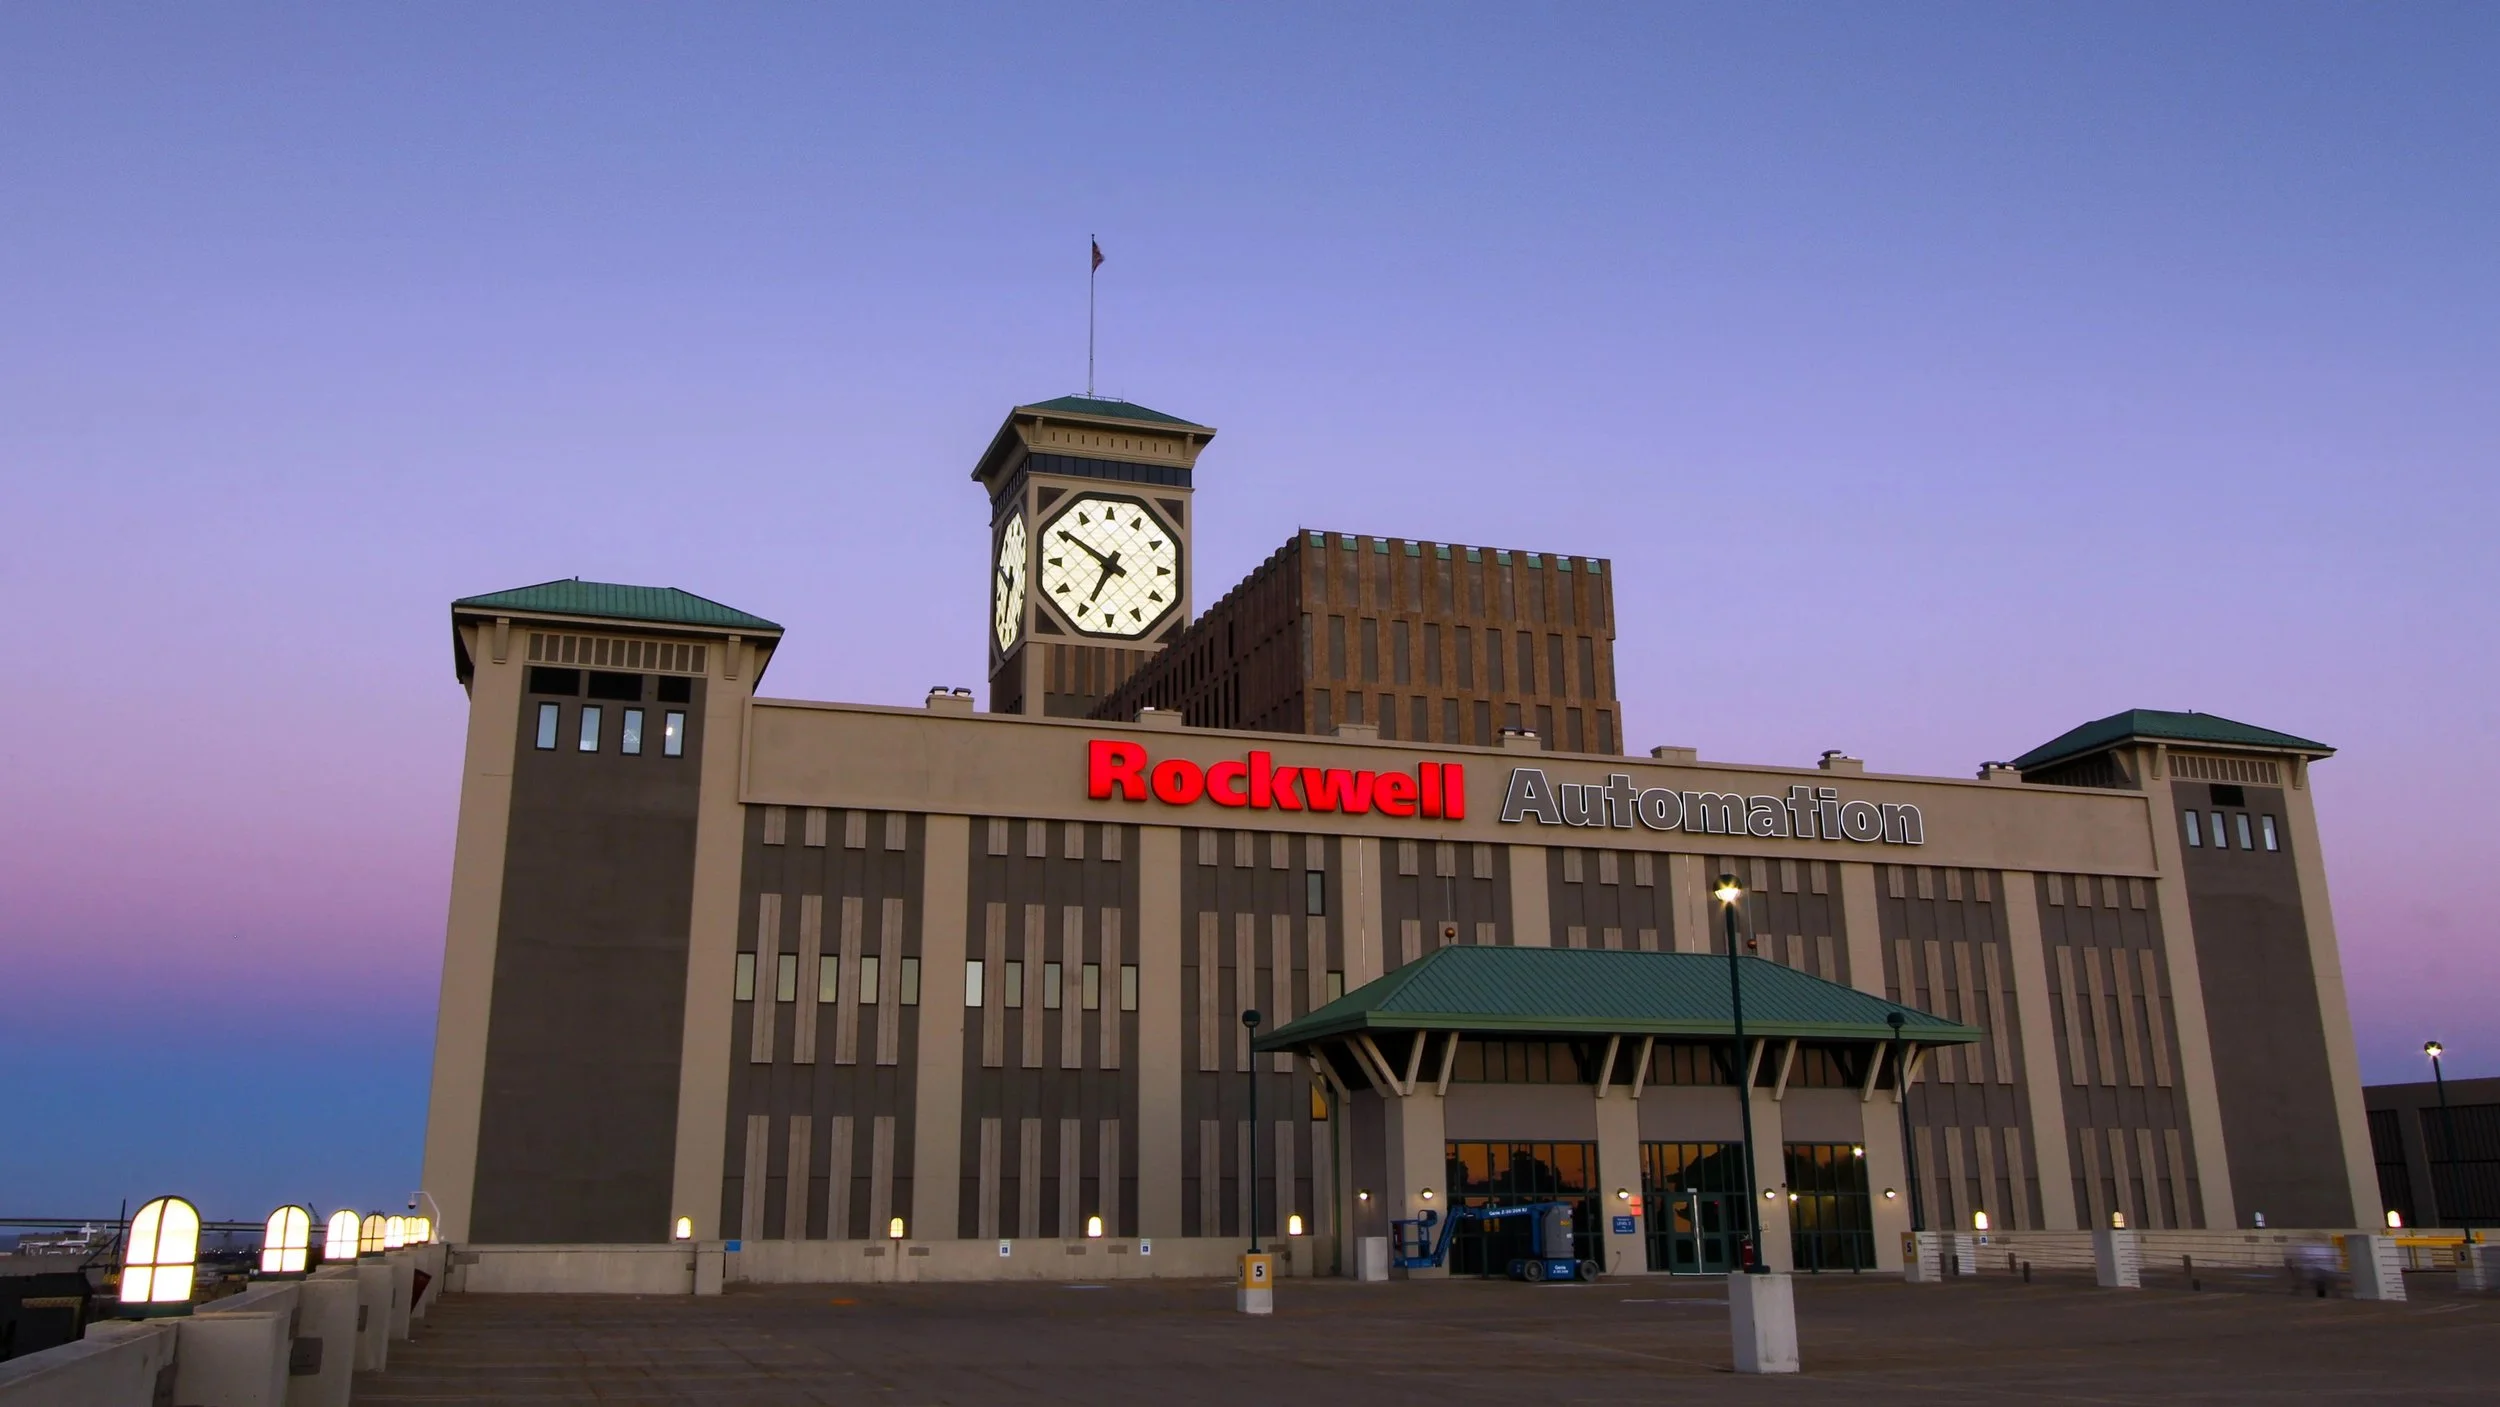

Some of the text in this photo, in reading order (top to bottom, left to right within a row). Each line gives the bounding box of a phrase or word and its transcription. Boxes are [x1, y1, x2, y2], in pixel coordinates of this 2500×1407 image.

[1088, 739, 1925, 846] Rockwell Automation
[1255, 1265, 1263, 1277] 5
